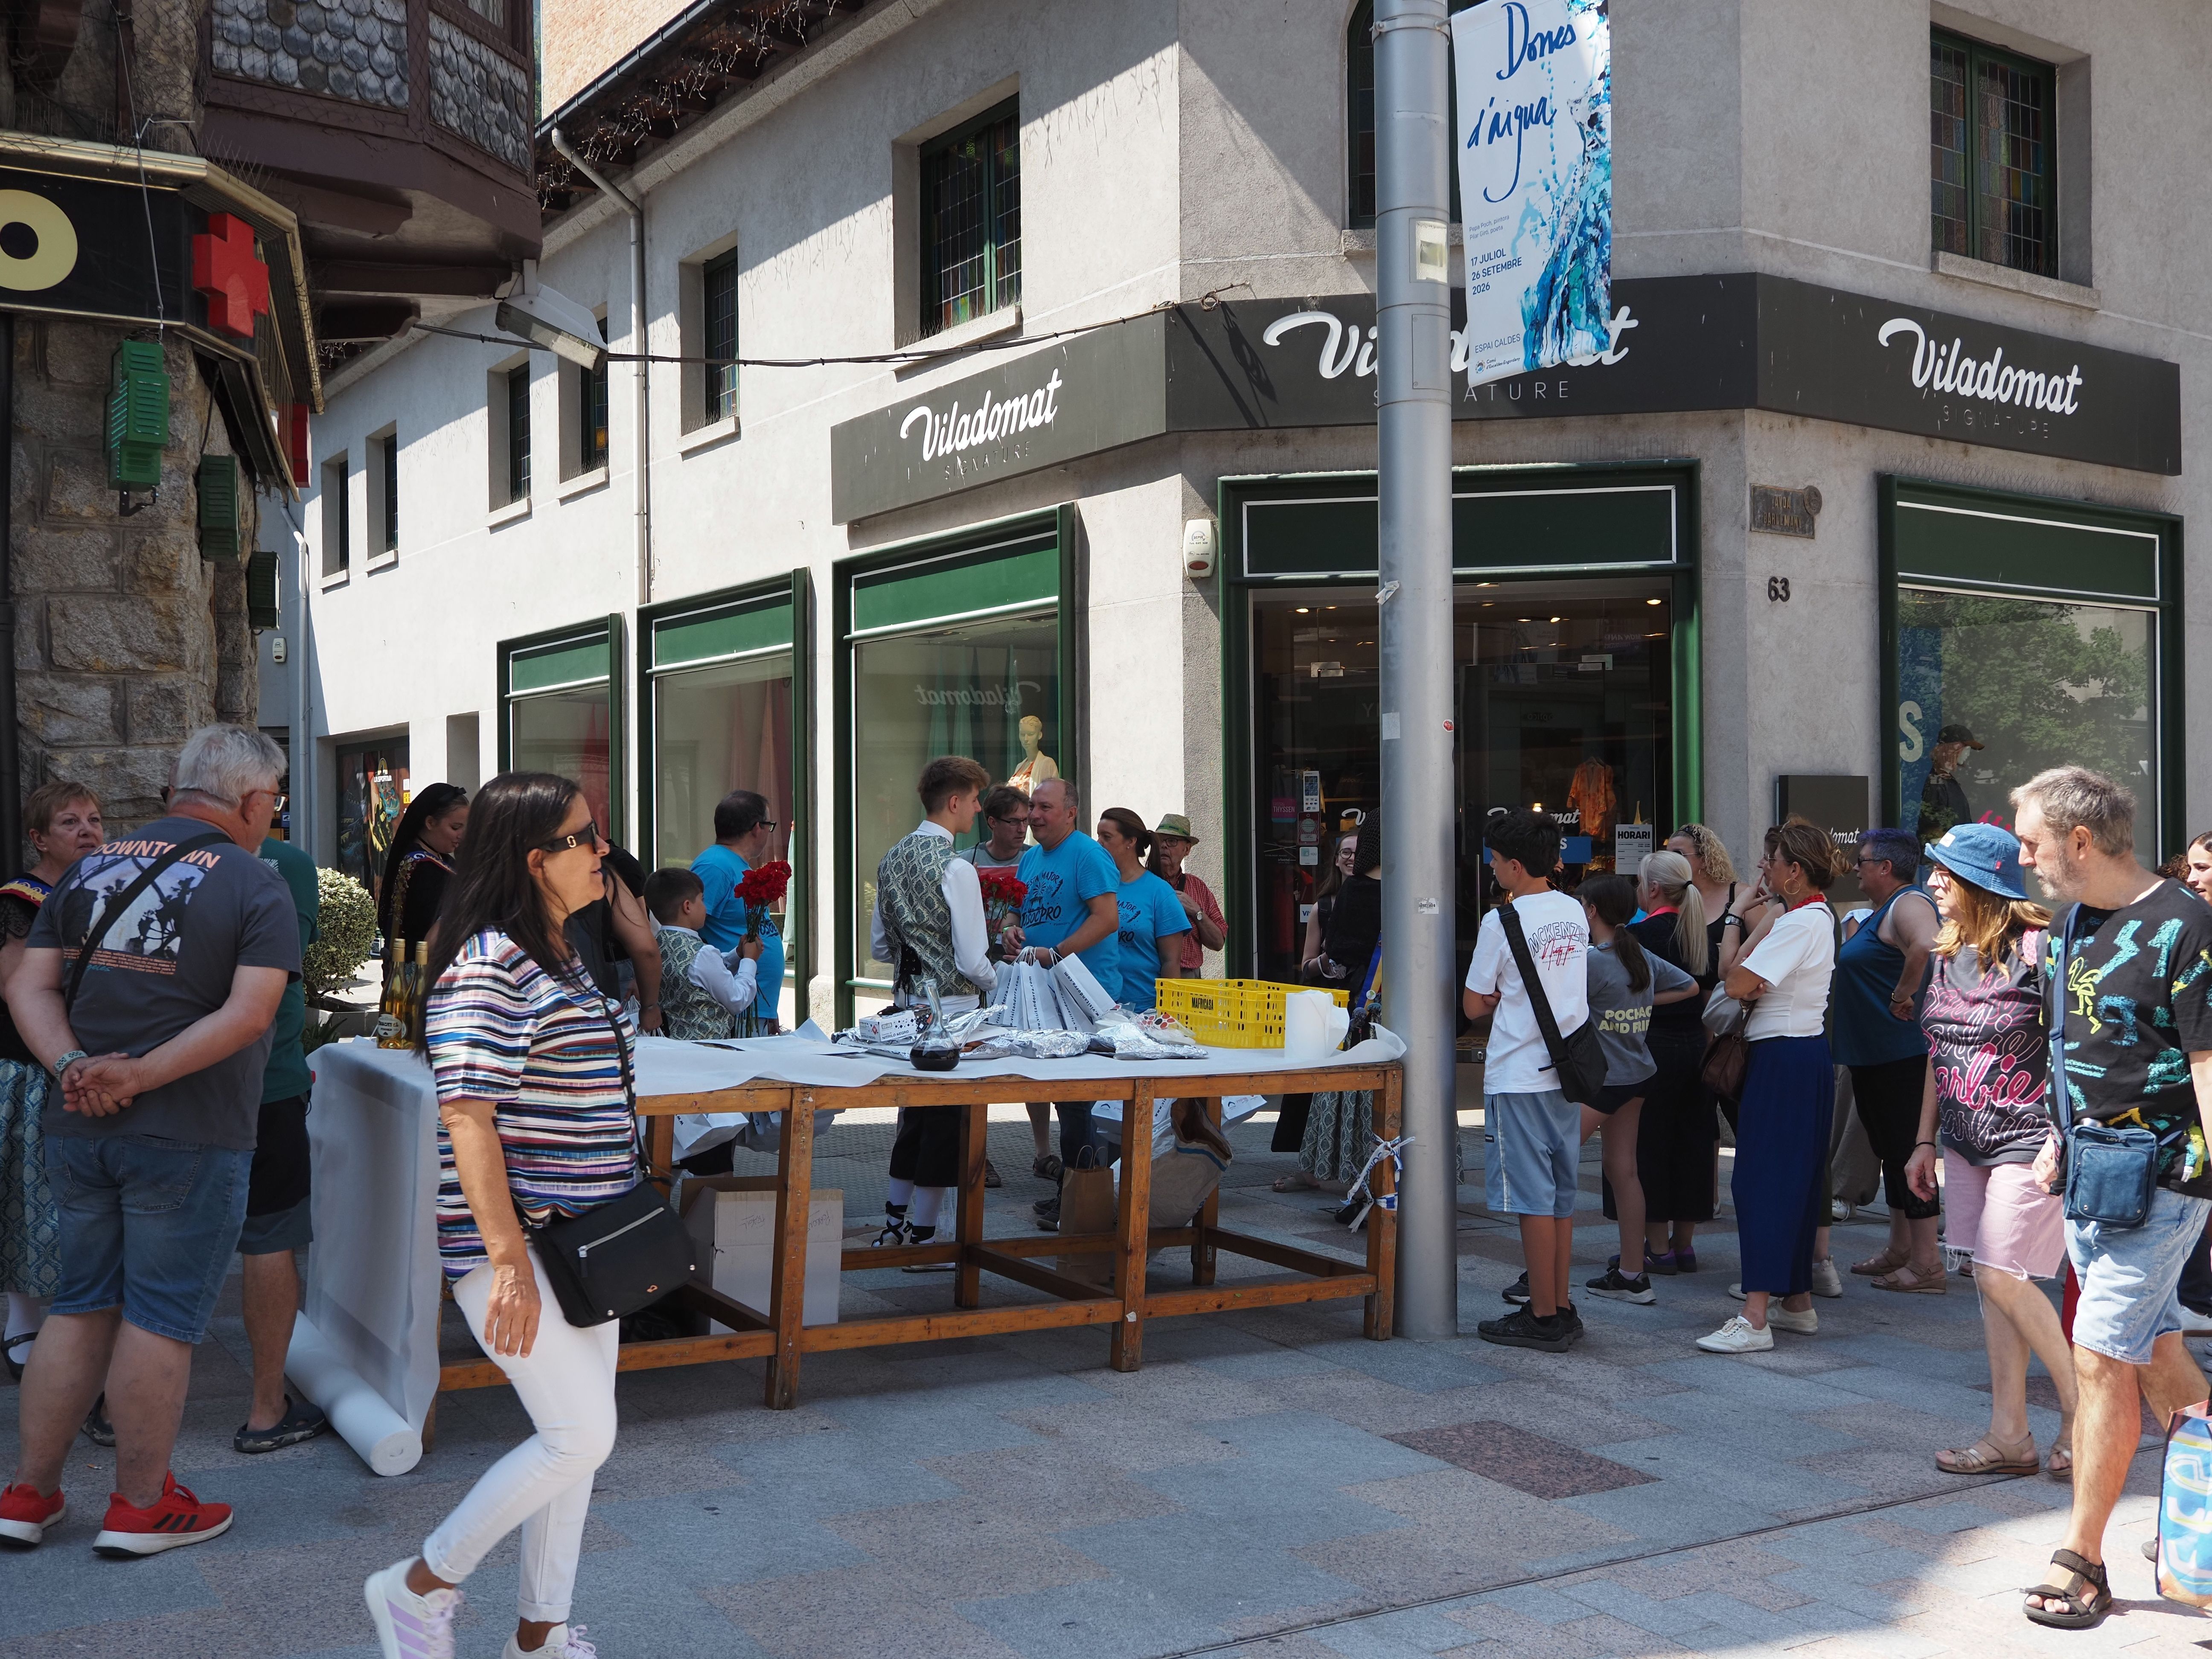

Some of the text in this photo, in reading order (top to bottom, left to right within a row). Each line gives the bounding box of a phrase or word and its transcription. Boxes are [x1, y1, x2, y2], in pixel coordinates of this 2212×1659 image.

[1496, 2, 1577, 80] Dones
[1480, 221, 1492, 229] Poch,
[1493, 215, 1509, 226] pintora
[1470, 226, 1503, 240] Pilar Giró, poeta
[1471, 248, 1506, 267] 17 JULIOL
[1472, 257, 1522, 281] 26 SETEMBRE
[1473, 282, 1490, 295] 2026
[1475, 334, 1521, 353] ESPAI CALDES
[1878, 318, 2082, 415] Viladomat
[900, 368, 1062, 462] Viladomat
[1943, 405, 2050, 439] SIGNATURE
[944, 440, 1031, 481] SIGNATURE
[1768, 576, 1790, 602] 63
[1027, 871, 1060, 889] ESTA MAJOR
[1528, 922, 1587, 958] MCKENZIE
[1191, 997, 1214, 1010] MAFRICASA
[1598, 1020, 1630, 1034] AND
